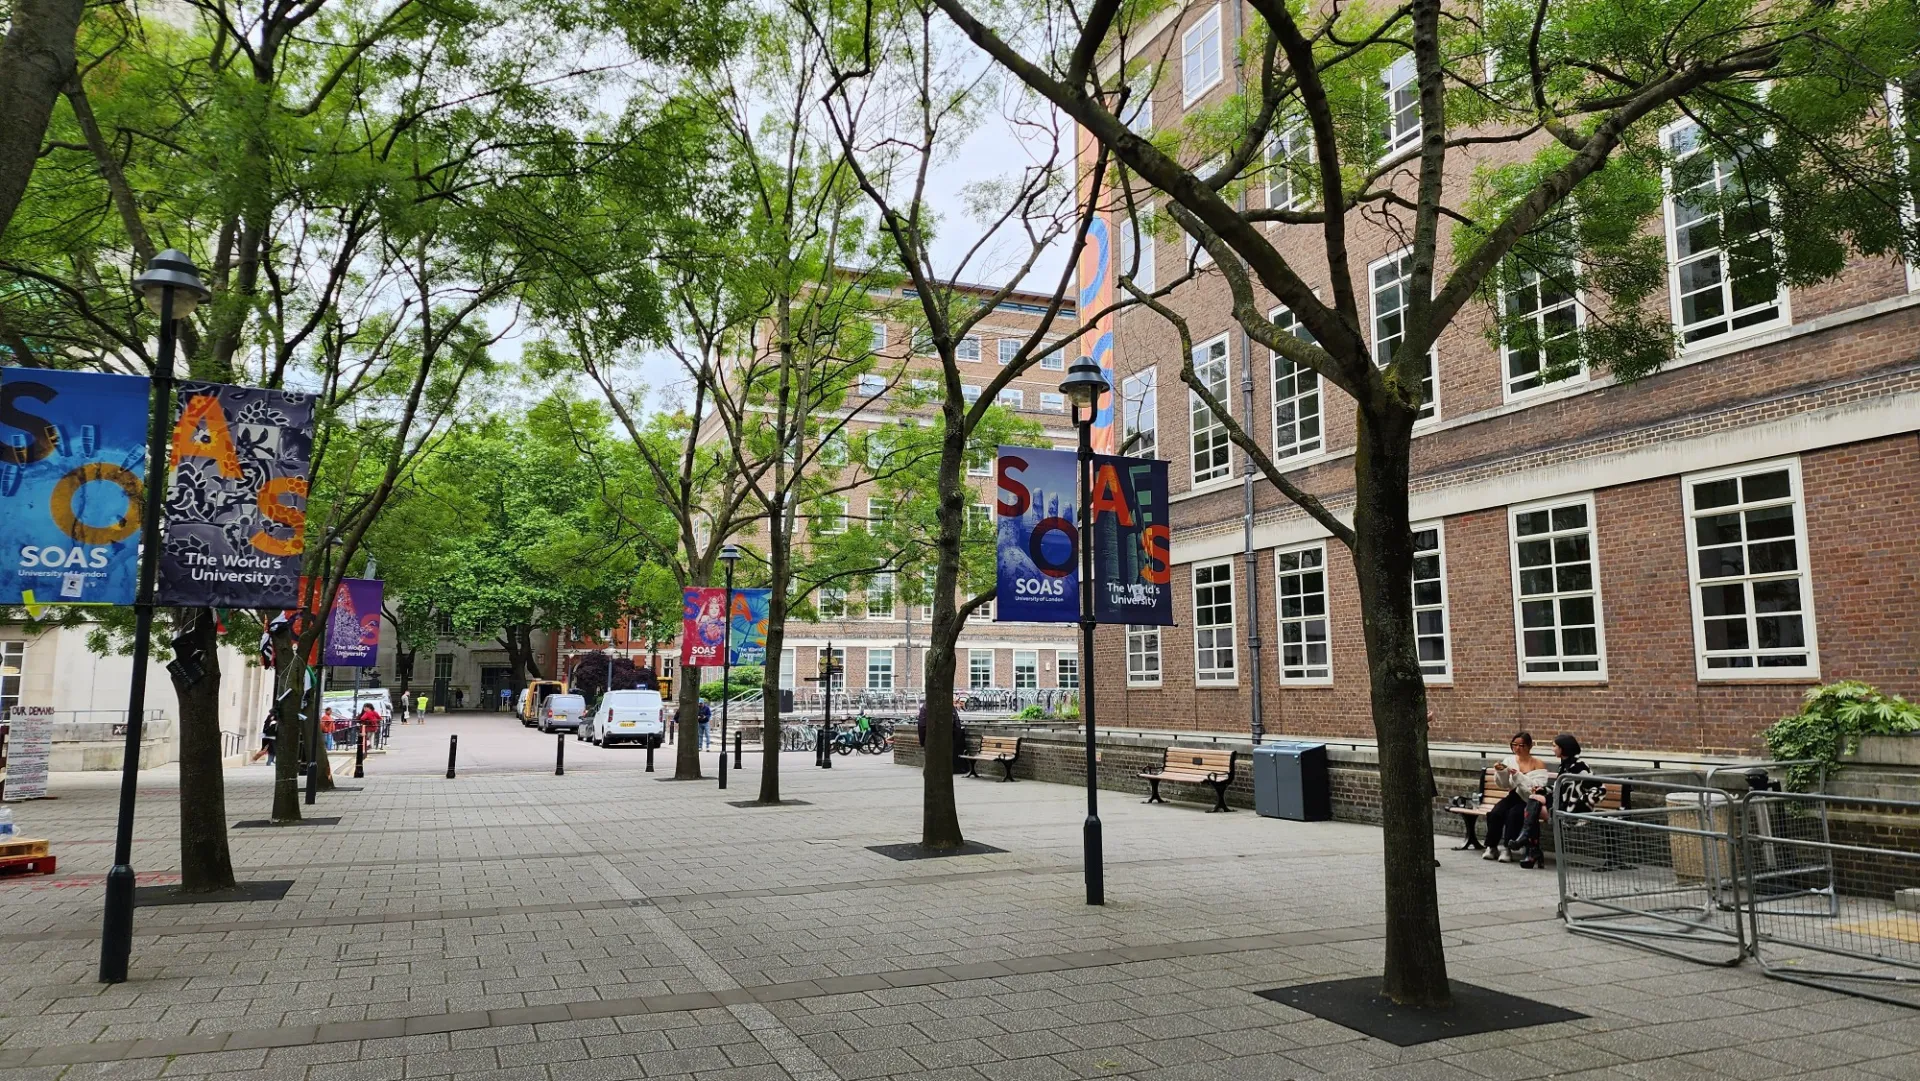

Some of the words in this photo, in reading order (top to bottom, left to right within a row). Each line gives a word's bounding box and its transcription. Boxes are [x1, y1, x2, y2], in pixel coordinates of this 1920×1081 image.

[20, 545, 108, 568] SOAS
[183, 552, 218, 566] The
[222, 554, 282, 569] World's
[18, 570, 62, 578] University
[191, 567, 275, 586] University
[1015, 578, 1064, 595] SOAS
[1106, 582, 1125, 593] The
[1126, 583, 1161, 595] Wld's
[691, 646, 717, 654] SOAS
[12, 706, 27, 716] OUR
